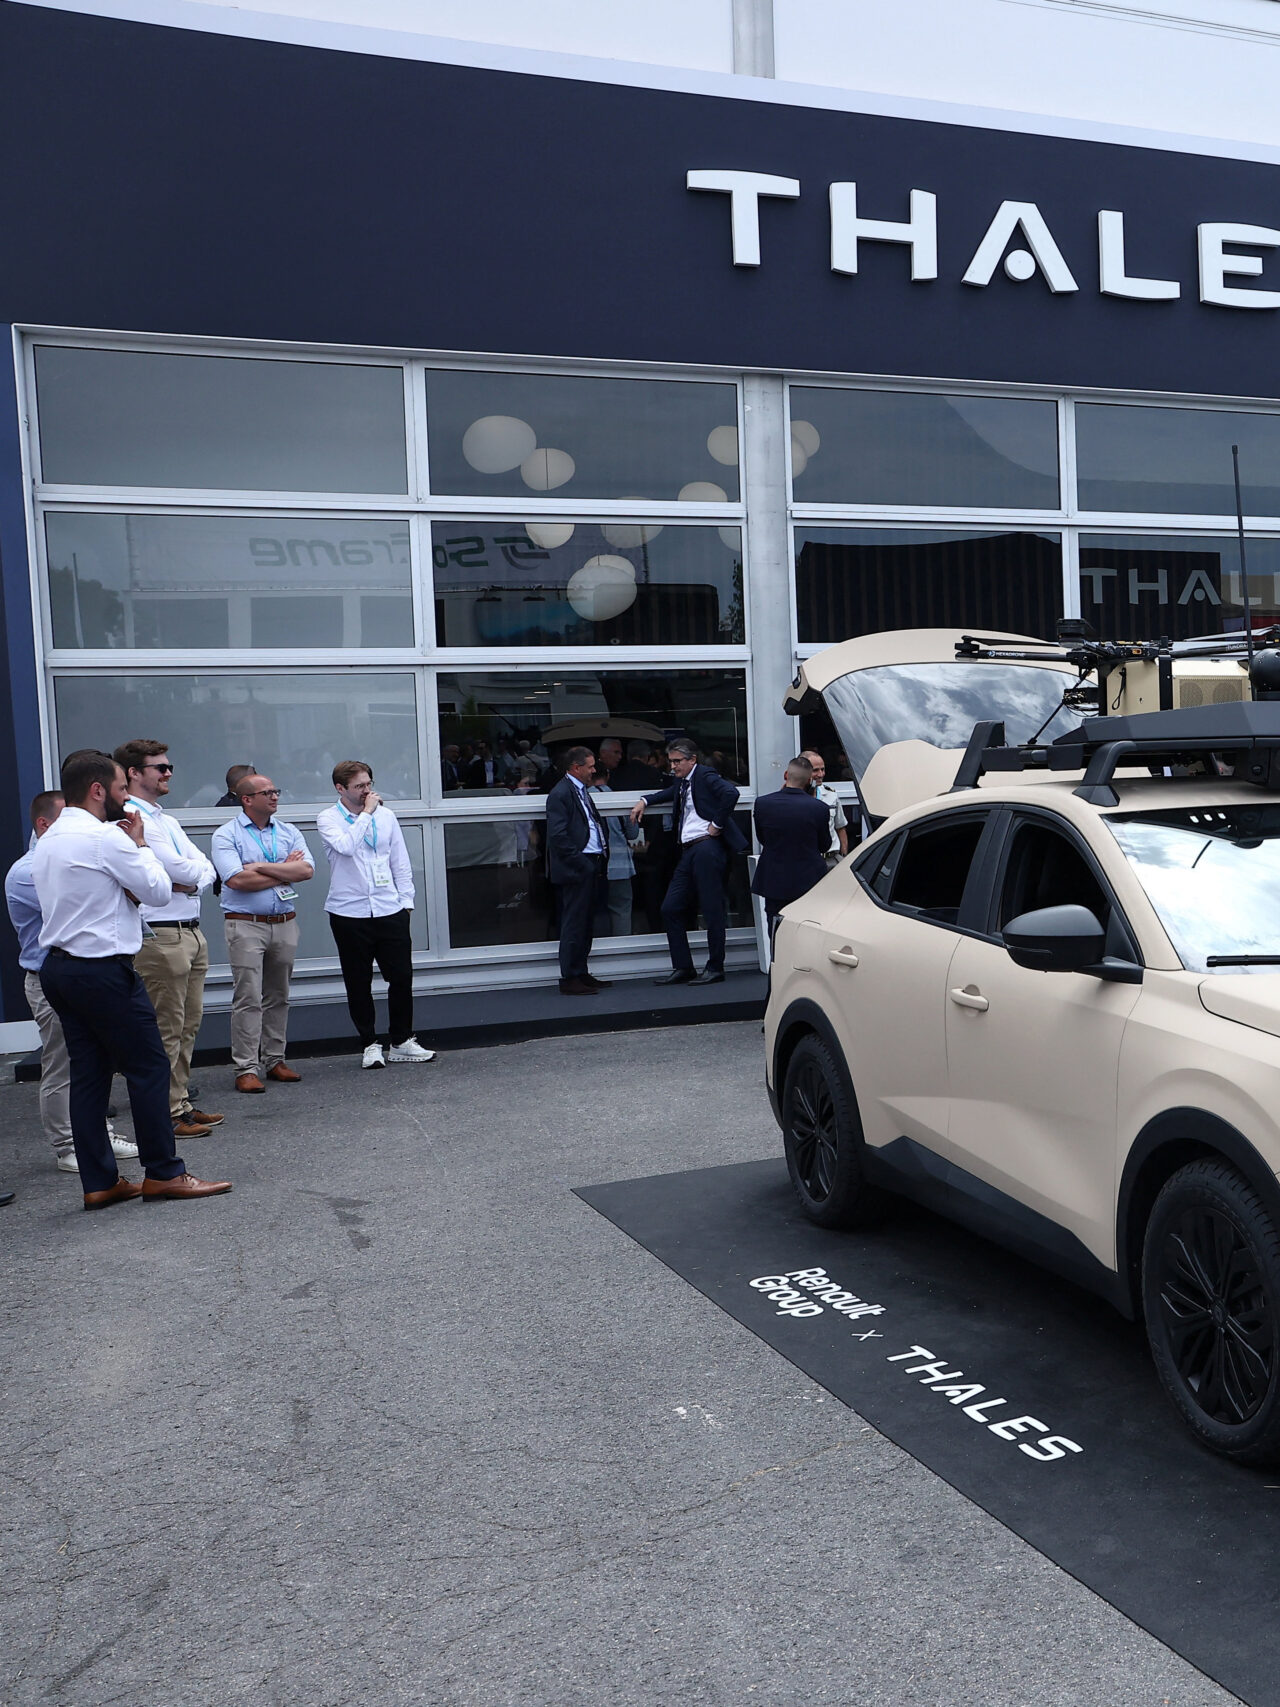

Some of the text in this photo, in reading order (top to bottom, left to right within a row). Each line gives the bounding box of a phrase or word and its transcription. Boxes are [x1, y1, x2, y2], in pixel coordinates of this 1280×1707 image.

[749, 1274, 824, 1318] Group
[785, 1266, 887, 1320] Renault
[886, 1344, 1084, 1462] THALES
